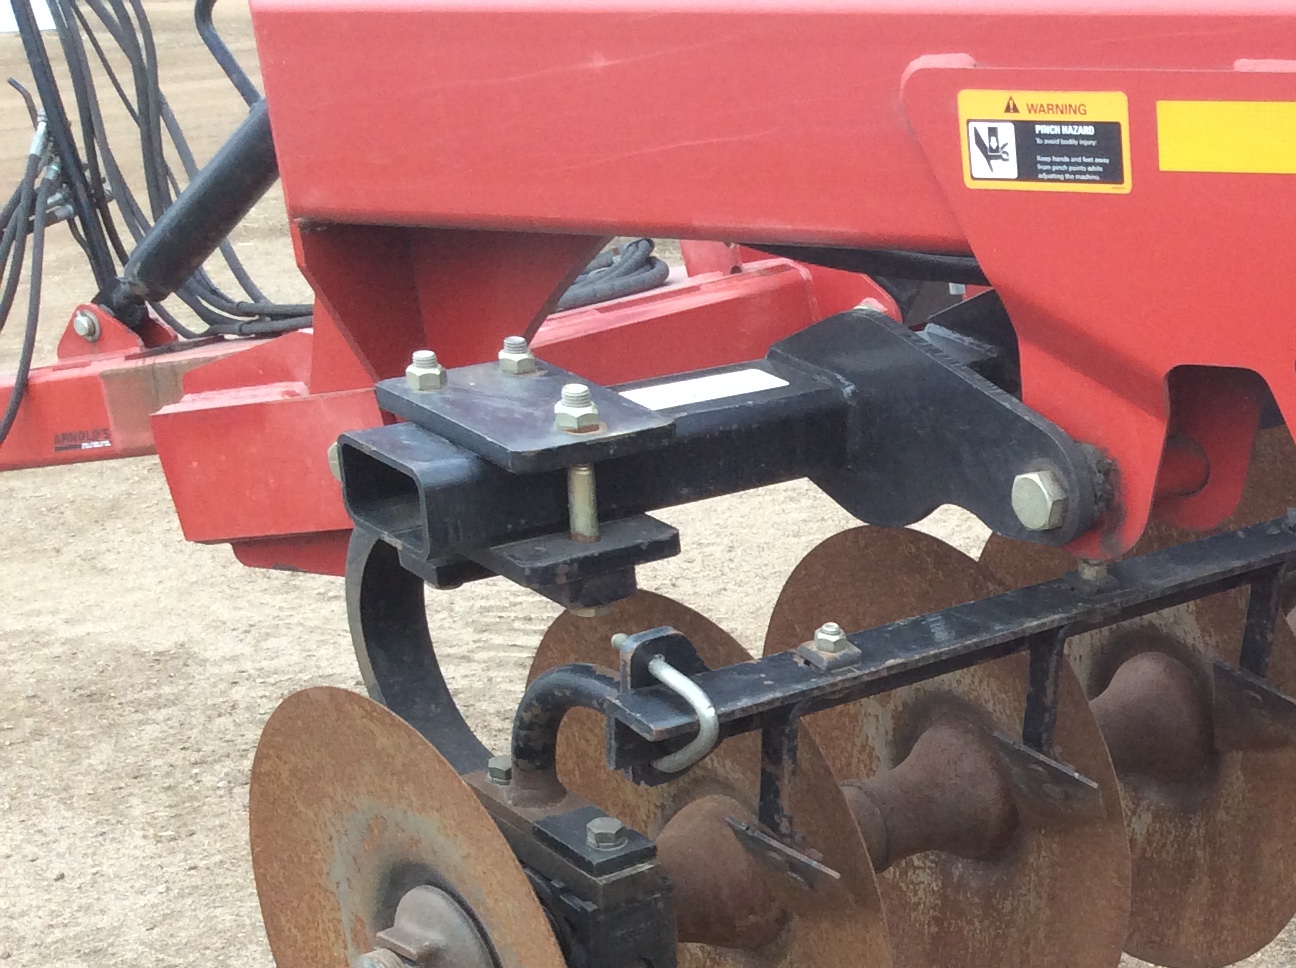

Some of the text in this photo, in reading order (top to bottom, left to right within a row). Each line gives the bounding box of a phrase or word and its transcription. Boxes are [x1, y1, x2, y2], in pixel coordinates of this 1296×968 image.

[1026, 103, 1087, 115] WARNING
[1035, 124, 1095, 135] PINCH HAZARD
[1060, 138, 1078, 146] bodily
